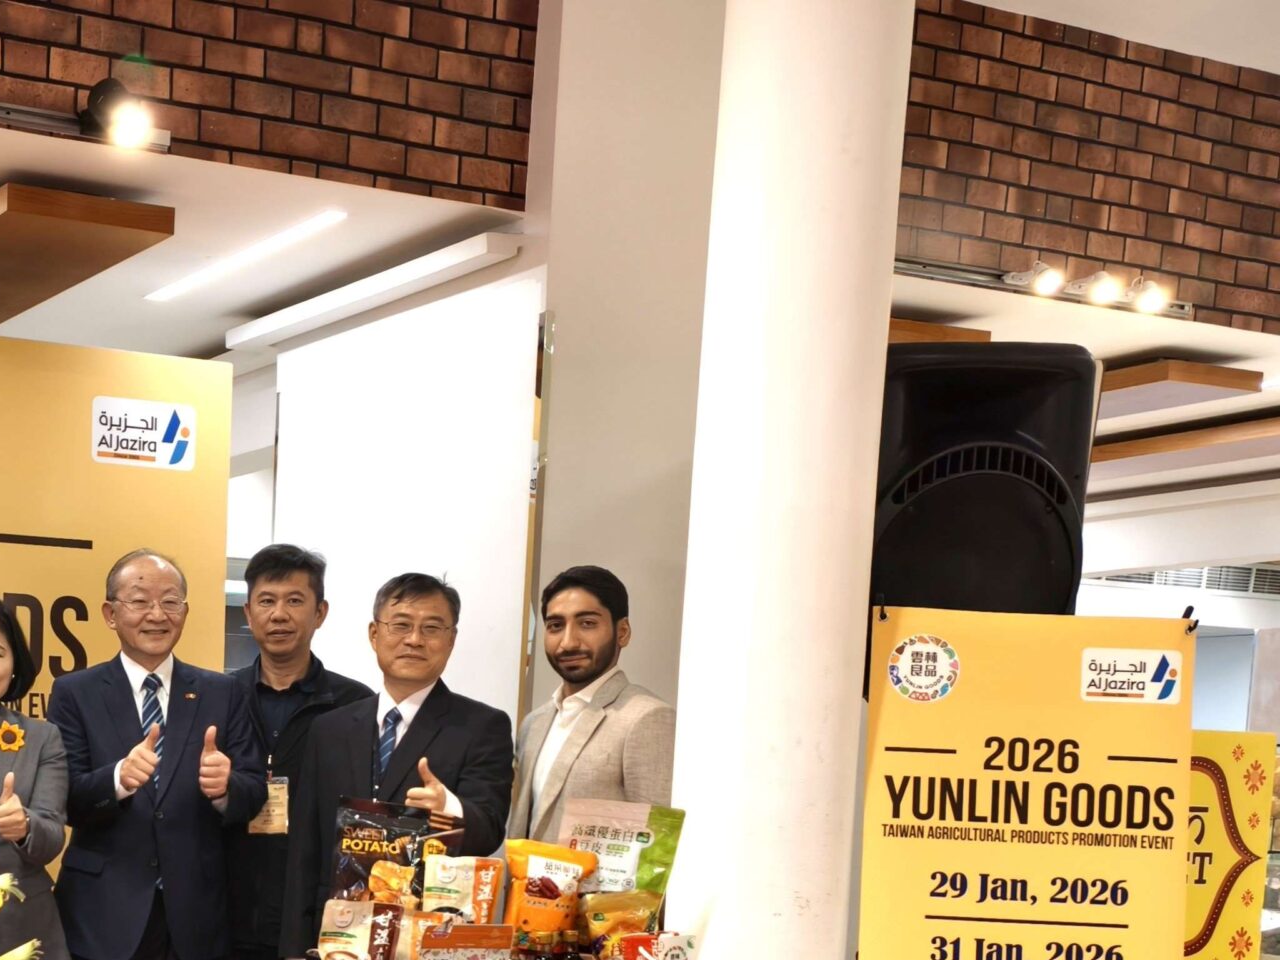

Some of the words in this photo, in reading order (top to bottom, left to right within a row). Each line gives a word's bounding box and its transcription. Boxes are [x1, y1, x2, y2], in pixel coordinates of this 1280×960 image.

[99, 411, 158, 433] الجزيرة
[1088, 659, 1147, 676] الجزيرة
[983, 736, 1080, 774] 2026
[884, 774, 1030, 825] YUNLIN
[1043, 781, 1175, 832] GOODS
[342, 838, 400, 854] POTATO
[882, 823, 924, 839] TAIWAN
[927, 826, 1007, 843] AGRICULTURAL
[1011, 829, 1069, 845] PRODUCTS
[1072, 832, 1138, 848] PROMOTION
[1140, 835, 1174, 850] EVENT
[929, 871, 968, 898] 29
[976, 873, 1038, 906] Jan,
[1049, 876, 1129, 906] 2026
